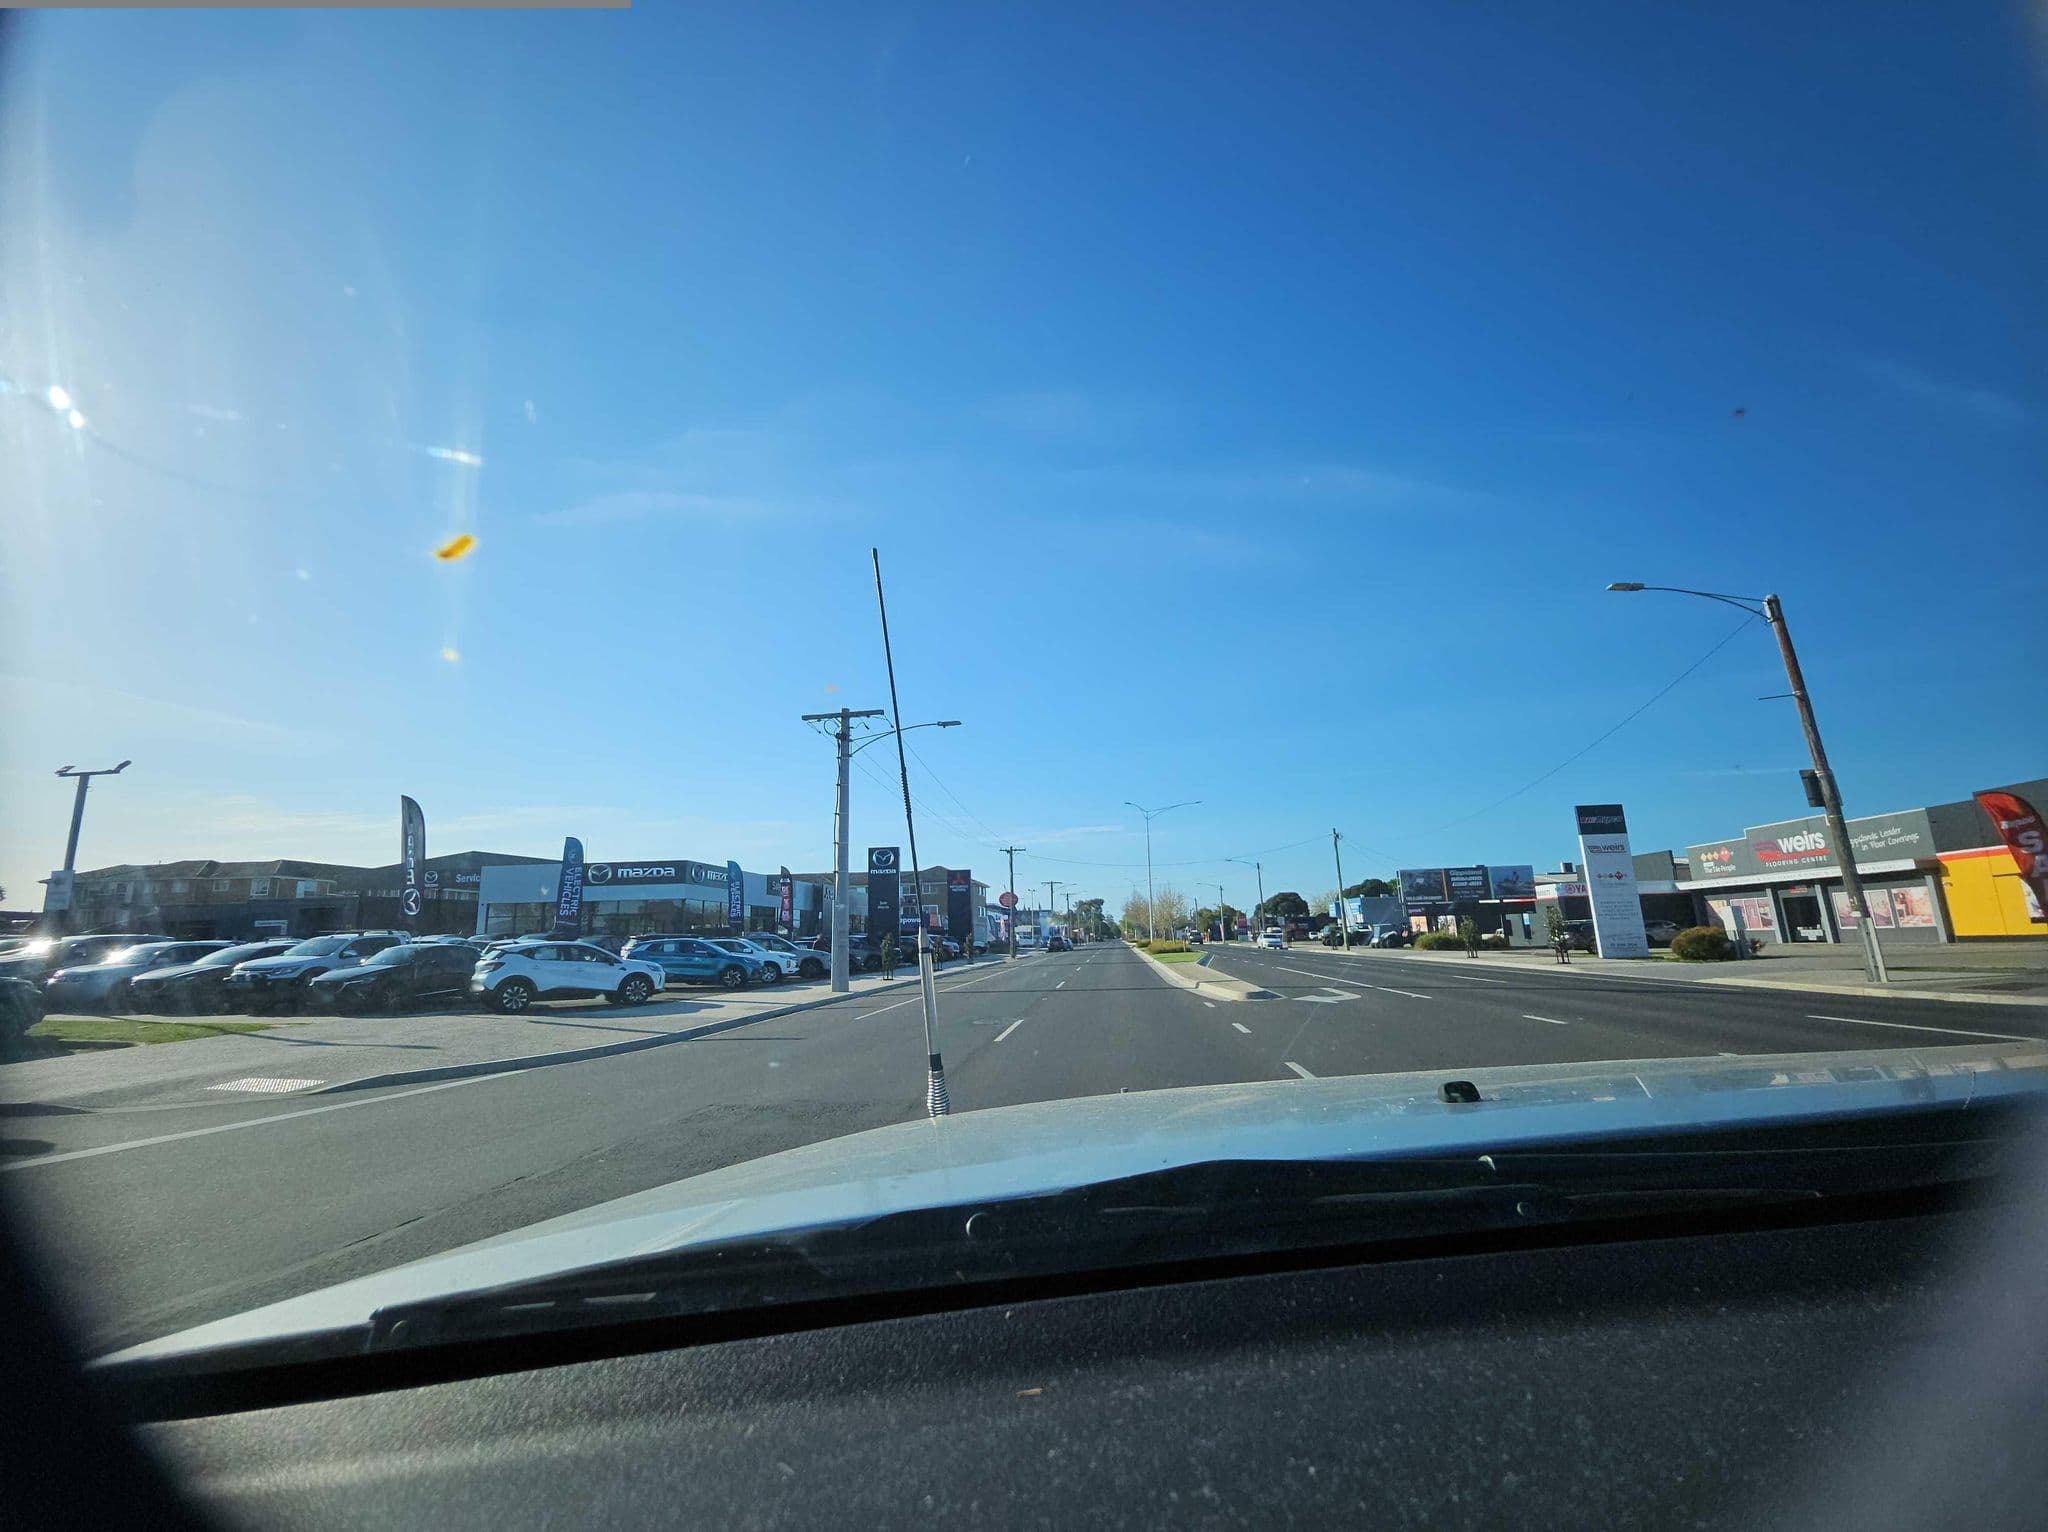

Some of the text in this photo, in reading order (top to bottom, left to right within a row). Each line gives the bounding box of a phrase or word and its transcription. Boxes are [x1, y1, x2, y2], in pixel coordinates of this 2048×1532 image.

[1601, 843, 1625, 851] weirs
[1777, 831, 1825, 853] weirs
[1765, 855, 1827, 867] FLOORING CENTRE
[455, 873, 480, 883] Servic
[618, 867, 675, 878] mazda
[707, 870, 728, 881] maz
[560, 867, 574, 917] VEHICLES
[569, 866, 582, 916] ELECTRIC
